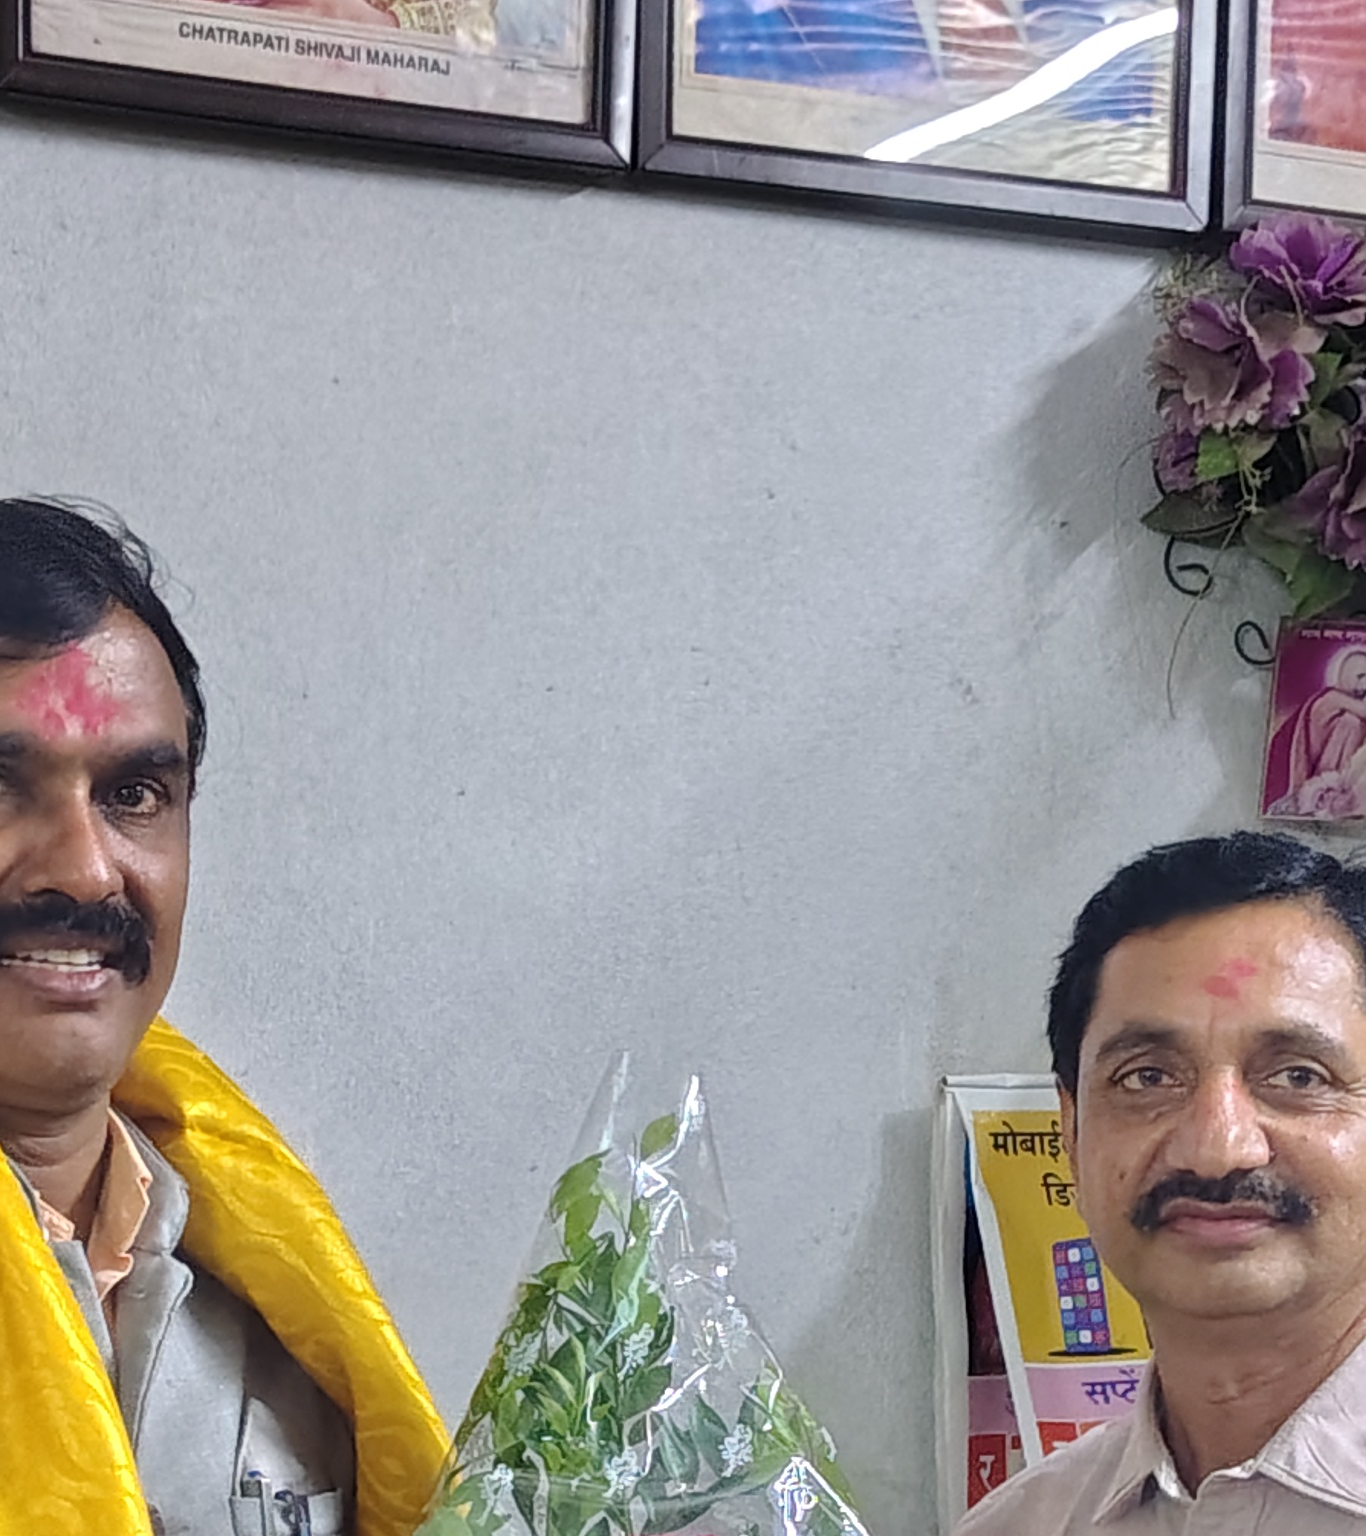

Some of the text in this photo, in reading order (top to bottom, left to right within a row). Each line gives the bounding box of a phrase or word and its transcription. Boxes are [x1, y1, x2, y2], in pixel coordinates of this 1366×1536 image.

[178, 22, 451, 76] CHATRAPATI SHIVAJI MAHARAJ
[988, 1120, 1066, 1164] मोबाई
[1040, 1172, 1076, 1207] डि
[1081, 1368, 1140, 1405] सप्टें
